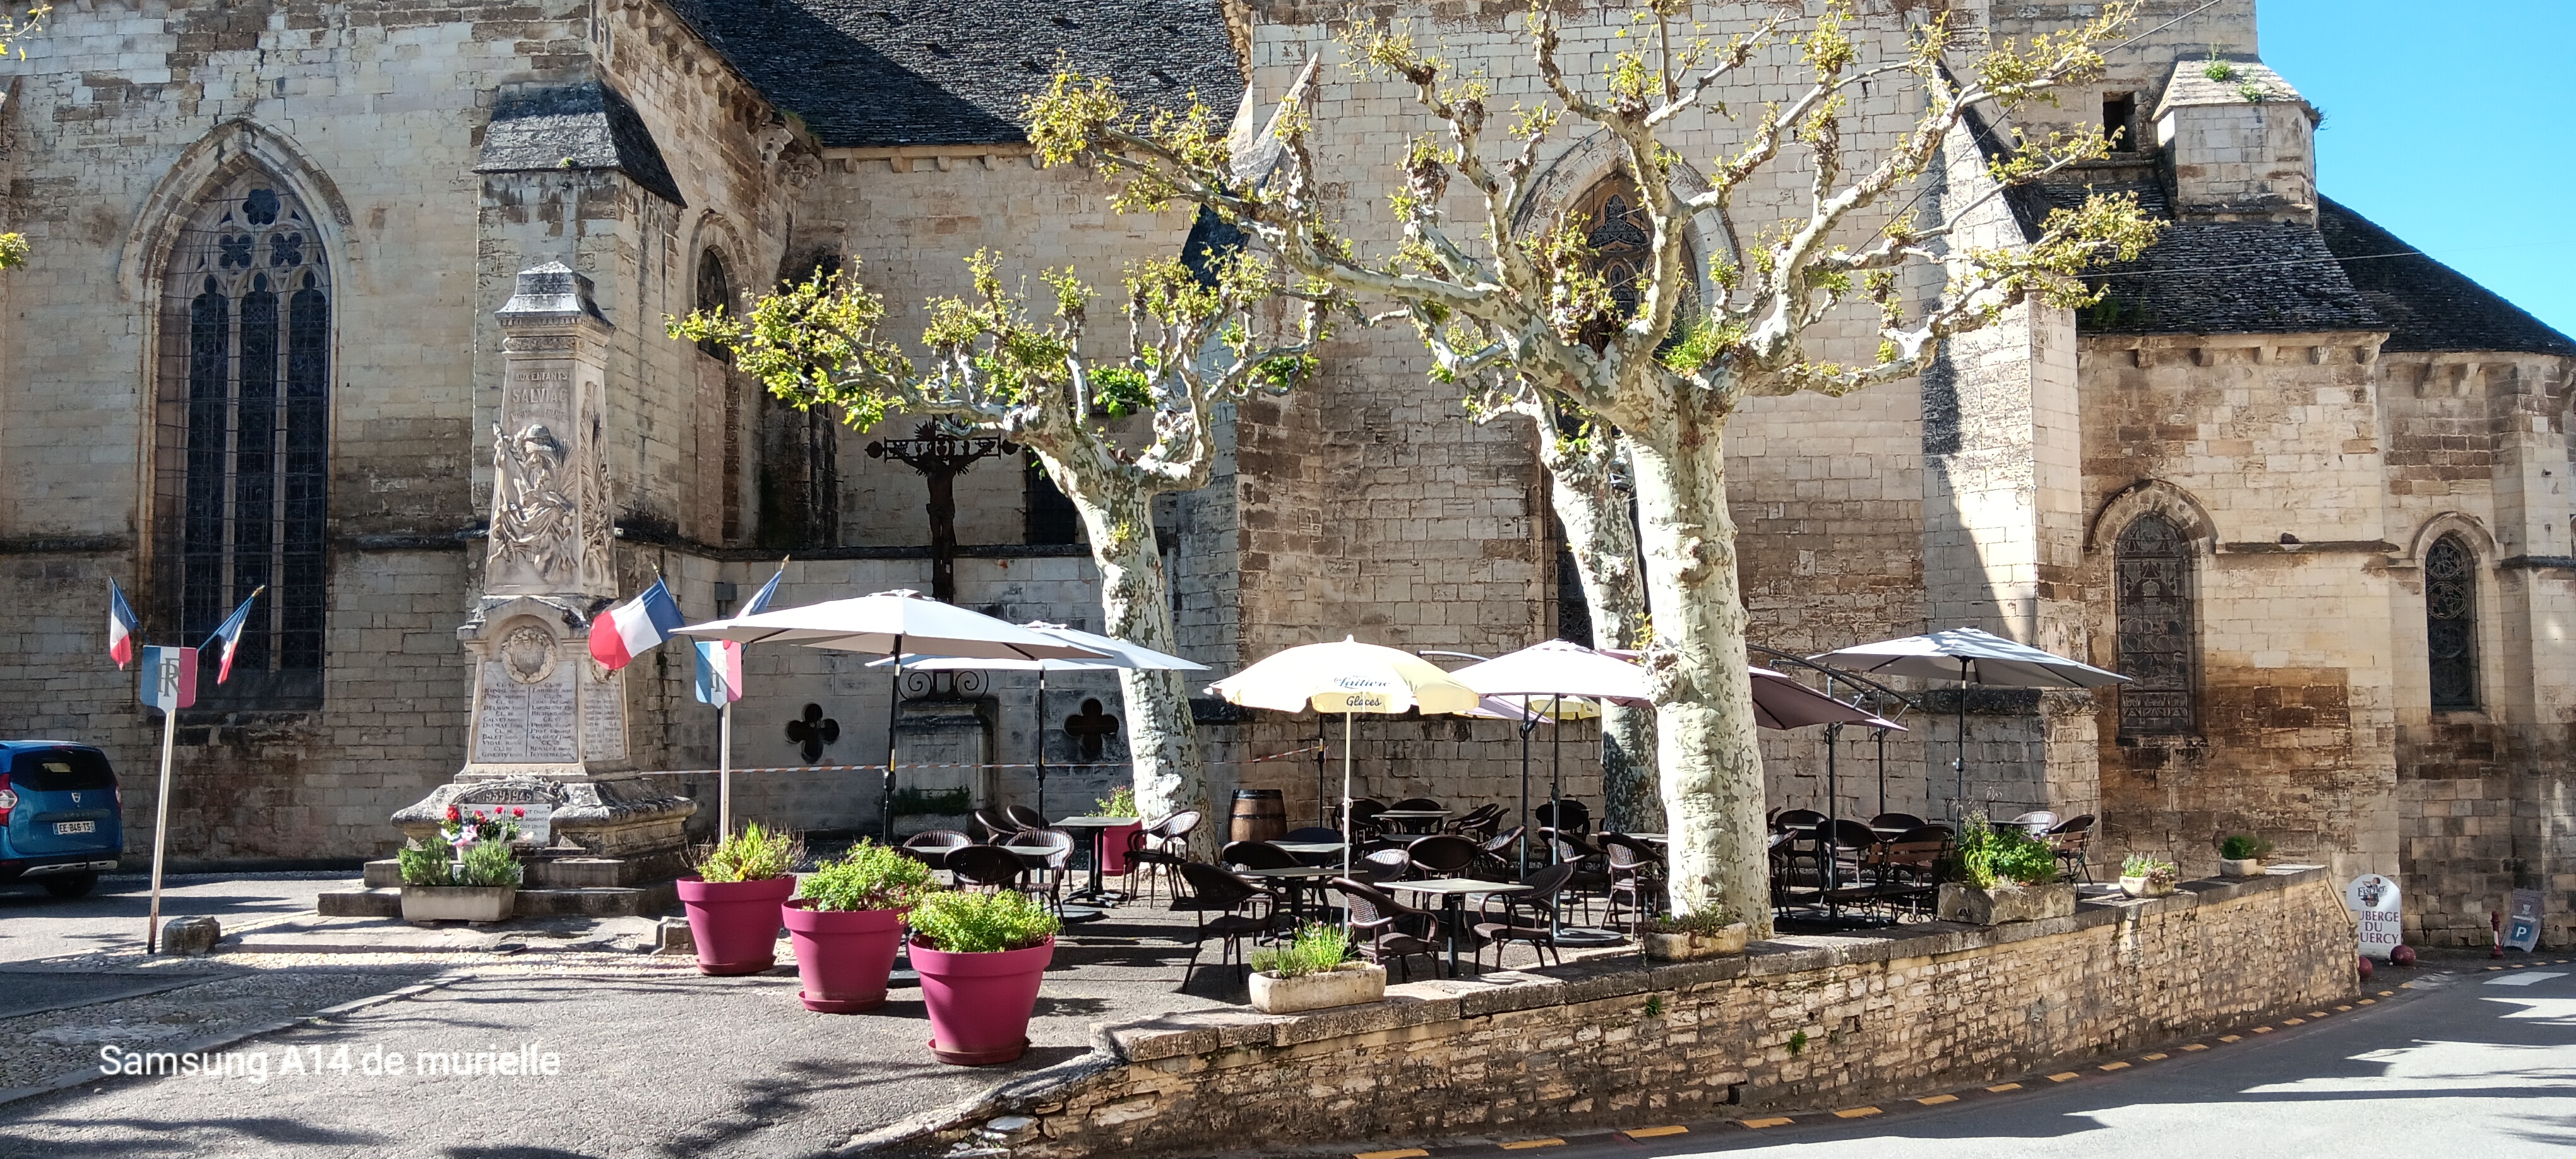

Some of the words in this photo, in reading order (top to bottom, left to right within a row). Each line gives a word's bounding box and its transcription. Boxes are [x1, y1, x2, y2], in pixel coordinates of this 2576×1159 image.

[531, 371, 568, 381] ENFANTS
[513, 388, 568, 403] SALVIAC
[1346, 696, 1381, 706] Glaces
[2365, 922, 2382, 932] DU
[2516, 926, 2527, 937] P
[2360, 932, 2399, 944] UERCY
